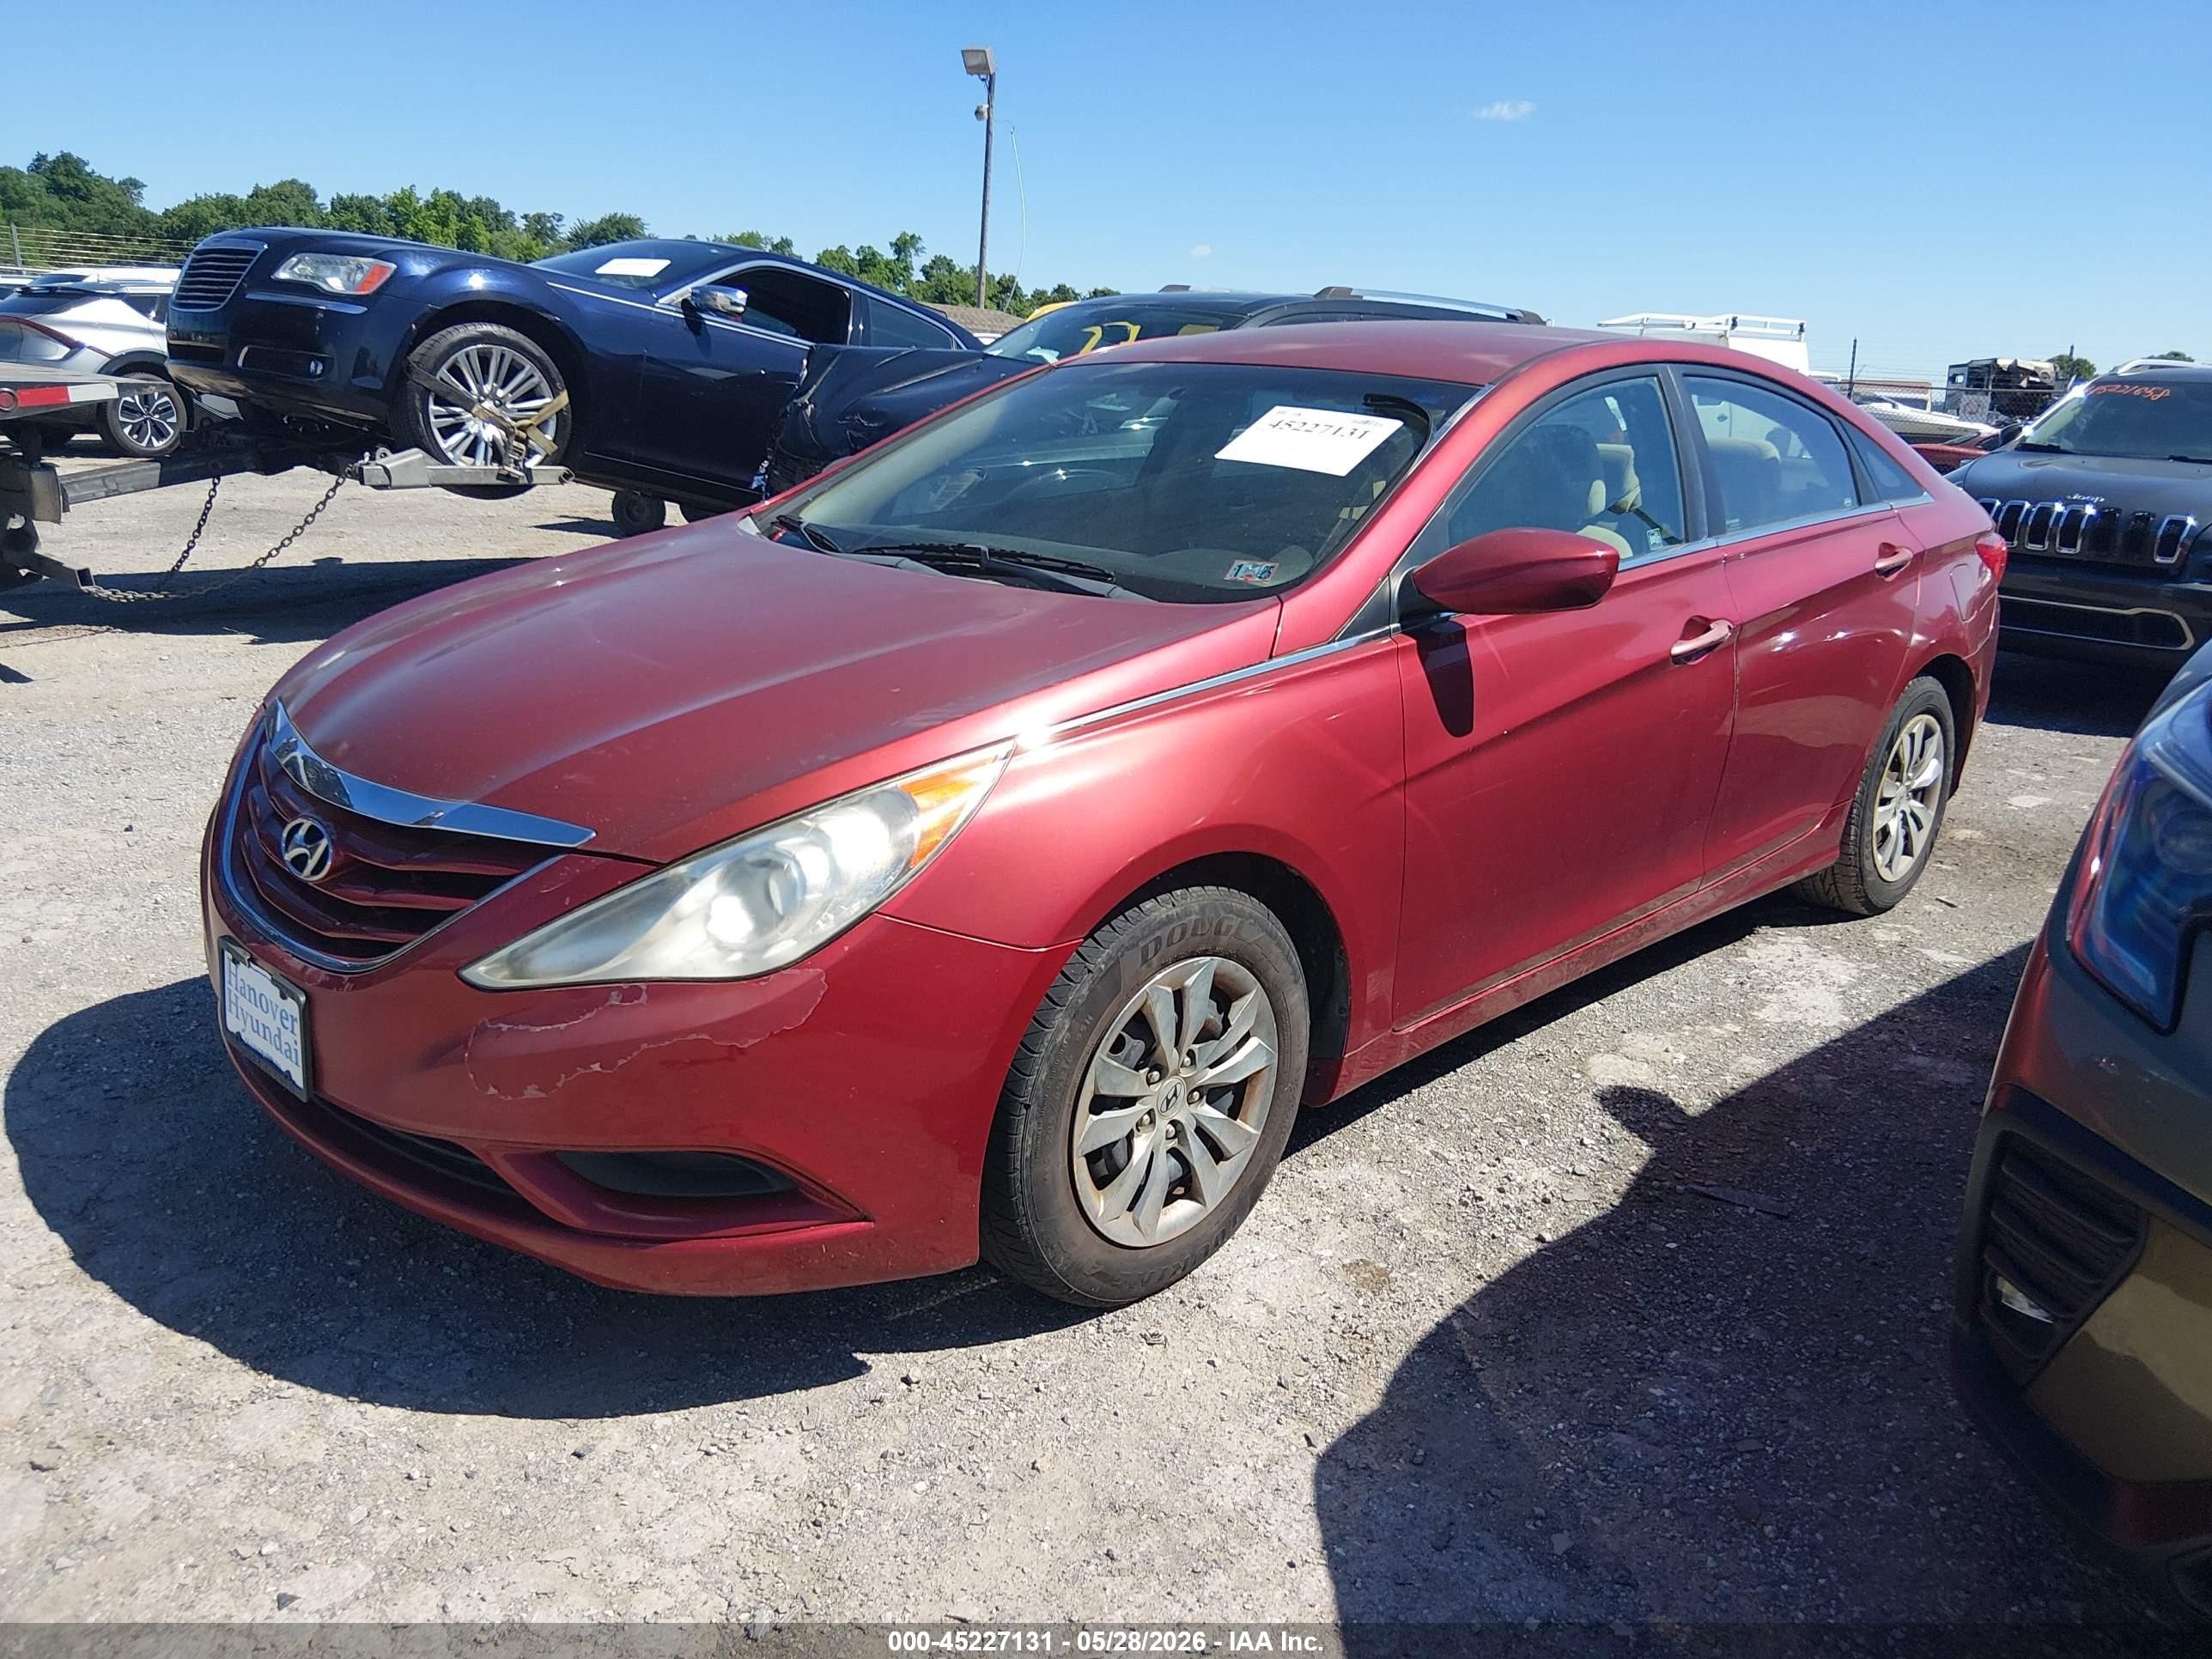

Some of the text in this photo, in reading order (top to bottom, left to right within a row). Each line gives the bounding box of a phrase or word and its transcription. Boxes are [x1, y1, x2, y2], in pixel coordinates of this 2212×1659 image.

[1269, 419, 1370, 439] 45227131
[228, 957, 298, 1036] Hanover
[228, 988, 301, 1066] Hyundai
